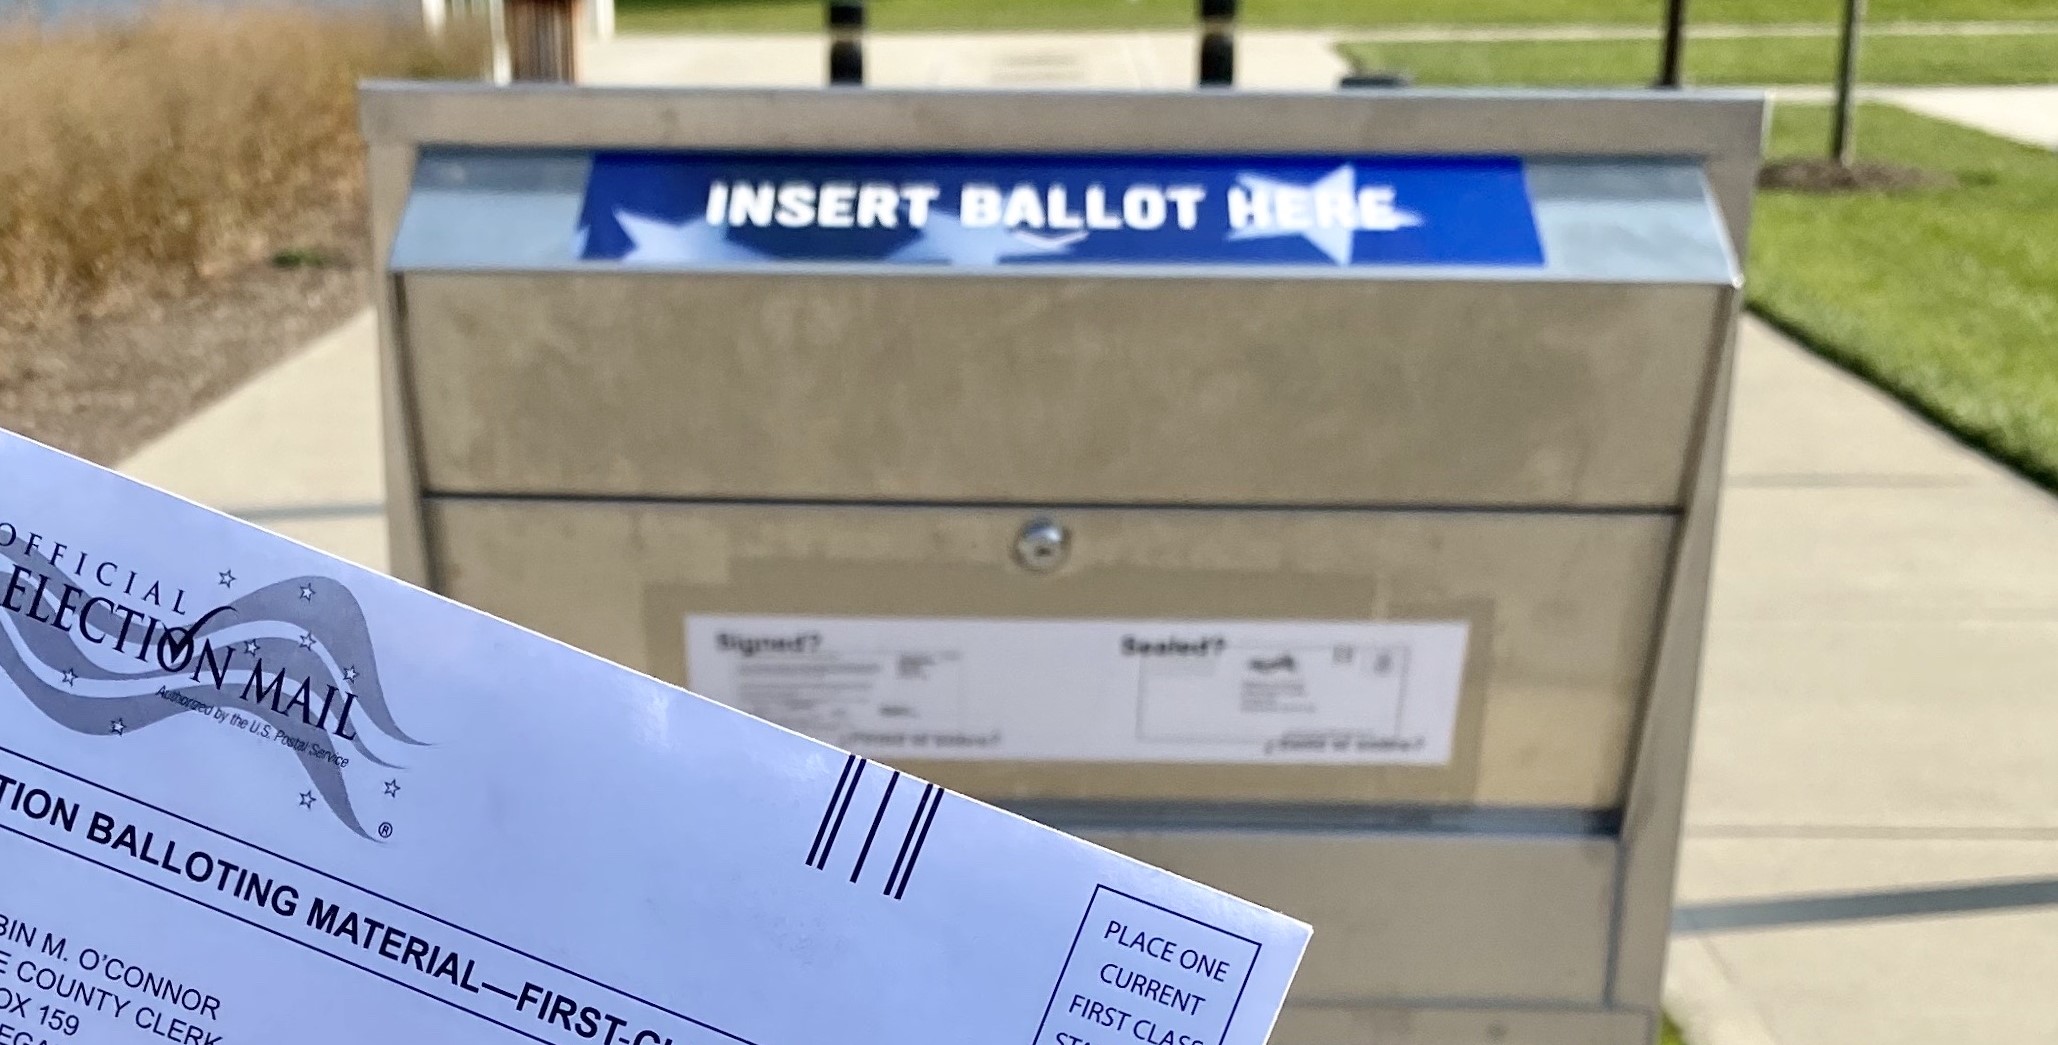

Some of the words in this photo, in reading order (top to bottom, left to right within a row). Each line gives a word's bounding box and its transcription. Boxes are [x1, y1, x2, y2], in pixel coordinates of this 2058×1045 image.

[704, 182, 941, 229] INSERT
[959, 183, 1206, 231] BALLOT
[1226, 184, 1398, 232] HERE
[0, 522, 186, 616] OFFICIAL
[0, 563, 236, 690] ELECTION
[239, 657, 358, 741] MAIL
[155, 685, 214, 715] Authorized
[213, 706, 230, 724] by
[230, 711, 249, 730] the
[248, 719, 271, 740] U.S.
[273, 729, 307, 752] Postal
[308, 742, 350, 768] Service
[86, 811, 299, 916] BALLOTING
[41, 932, 68, 962] M.
[79, 948, 221, 1021] O'CONNOR
[1100, 963, 1206, 1016] CURRENT
[1104, 920, 1177, 962] PLACE
[1180, 949, 1230, 982] ONE
[17, 961, 131, 1018] COUNTY
[135, 1007, 223, 1045] CLERK
[40, 1005, 79, 1036] 159
[1069, 994, 1132, 1031] FIRST
